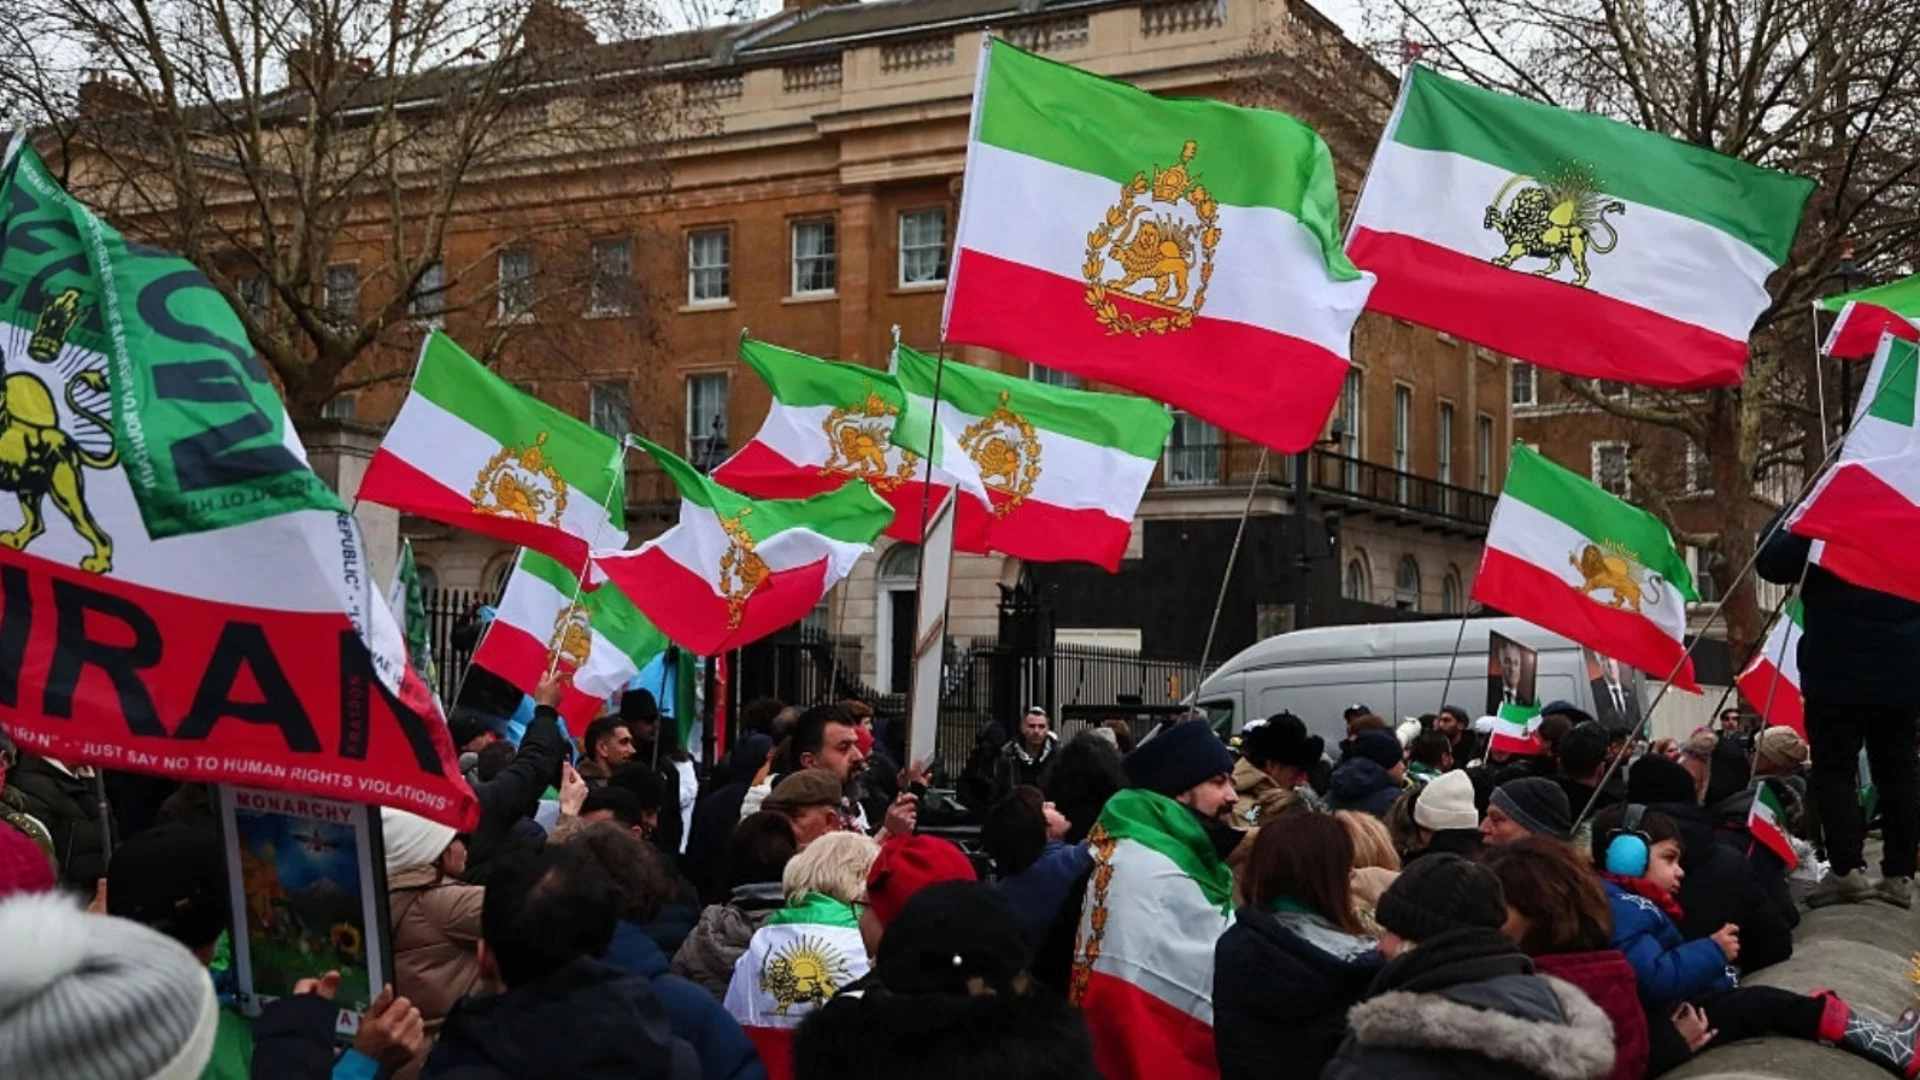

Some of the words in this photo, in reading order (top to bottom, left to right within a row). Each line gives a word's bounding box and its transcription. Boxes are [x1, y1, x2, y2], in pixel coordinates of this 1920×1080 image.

[0, 564, 446, 778] IRAN
[127, 750, 158, 766] SAY
[163, 757, 189, 770] NO
[194, 756, 219, 771] TO
[223, 757, 286, 777] HUMAN
[290, 767, 353, 789] RIGHTS
[236, 791, 352, 823] MONARCHY
